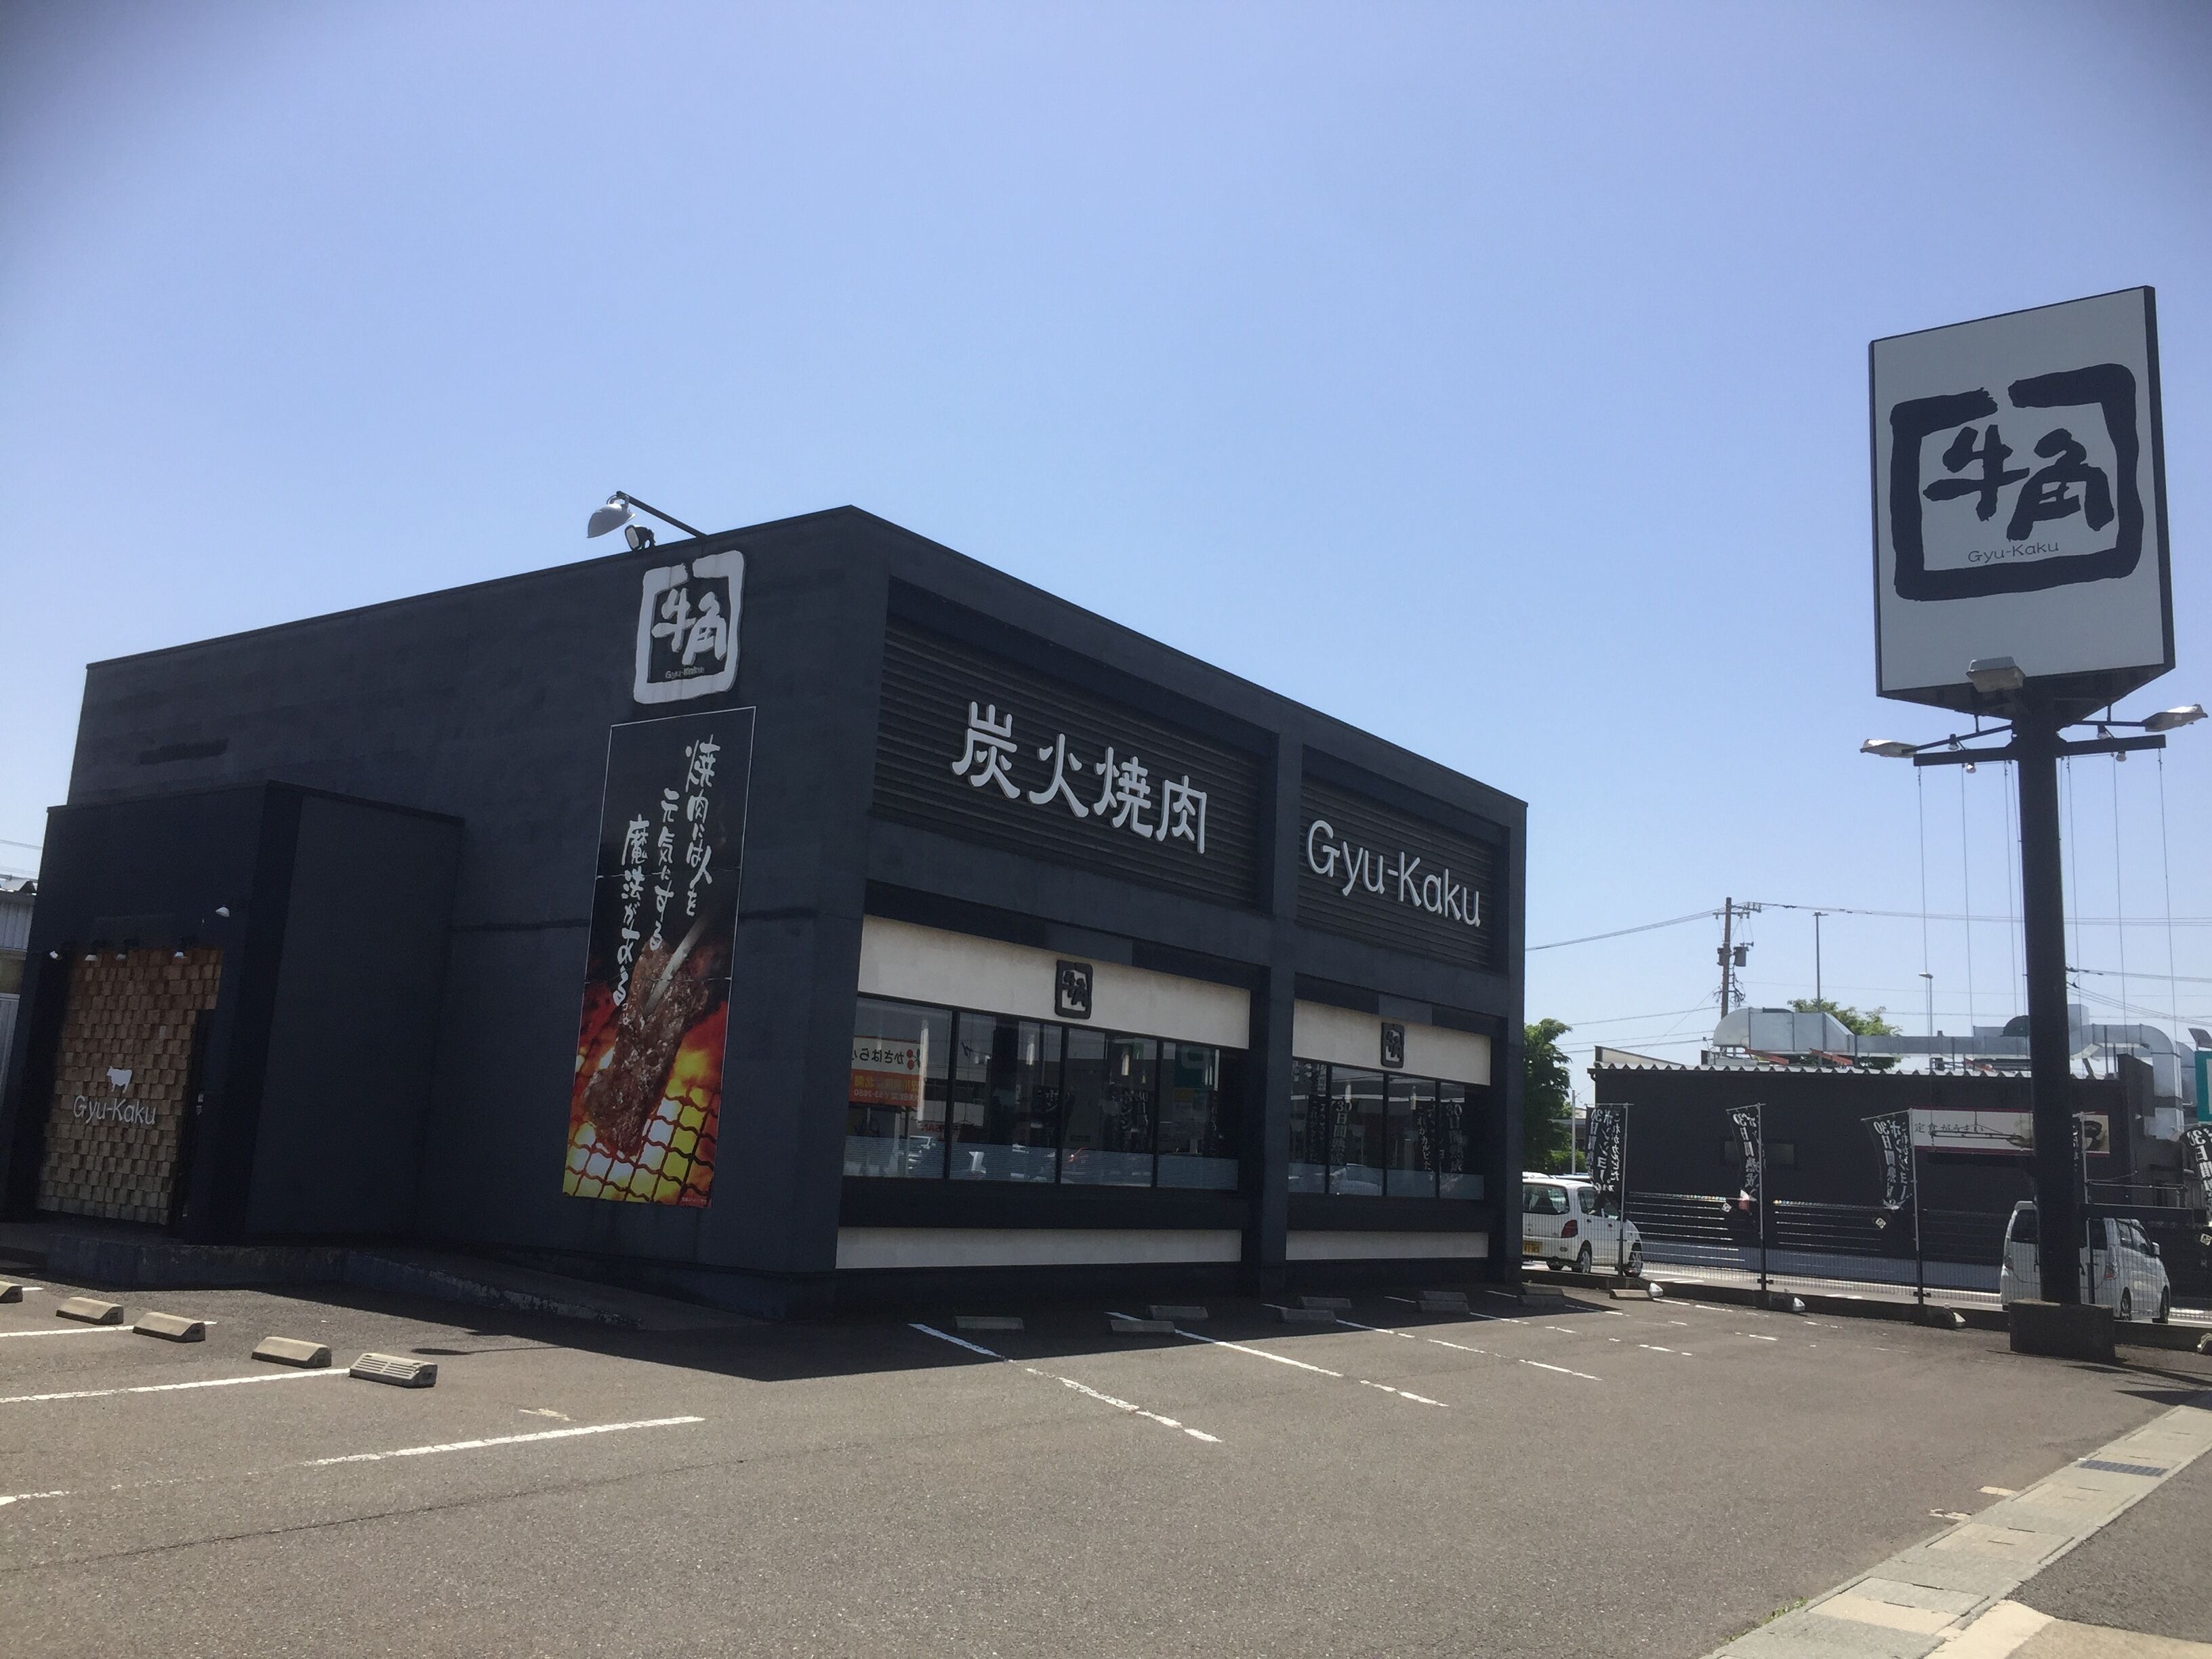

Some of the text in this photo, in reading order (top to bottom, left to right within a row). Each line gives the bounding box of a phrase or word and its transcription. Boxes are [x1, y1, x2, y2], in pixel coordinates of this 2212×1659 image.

[1923, 424, 2114, 541] 牛角
[1967, 541, 2060, 564] Gyu-Kaku
[651, 587, 727, 665] 牛角
[686, 735, 720, 916] 焼肉には人を
[951, 701, 1208, 854] 炭火焼肉
[613, 814, 650, 1006] 魔法がある
[650, 788, 680, 950] 元気にする
[1307, 819, 1480, 927] Gyu-Kaku
[1063, 970, 1088, 1007] 牛角
[73, 1094, 156, 1125] Gyu-Kaku
